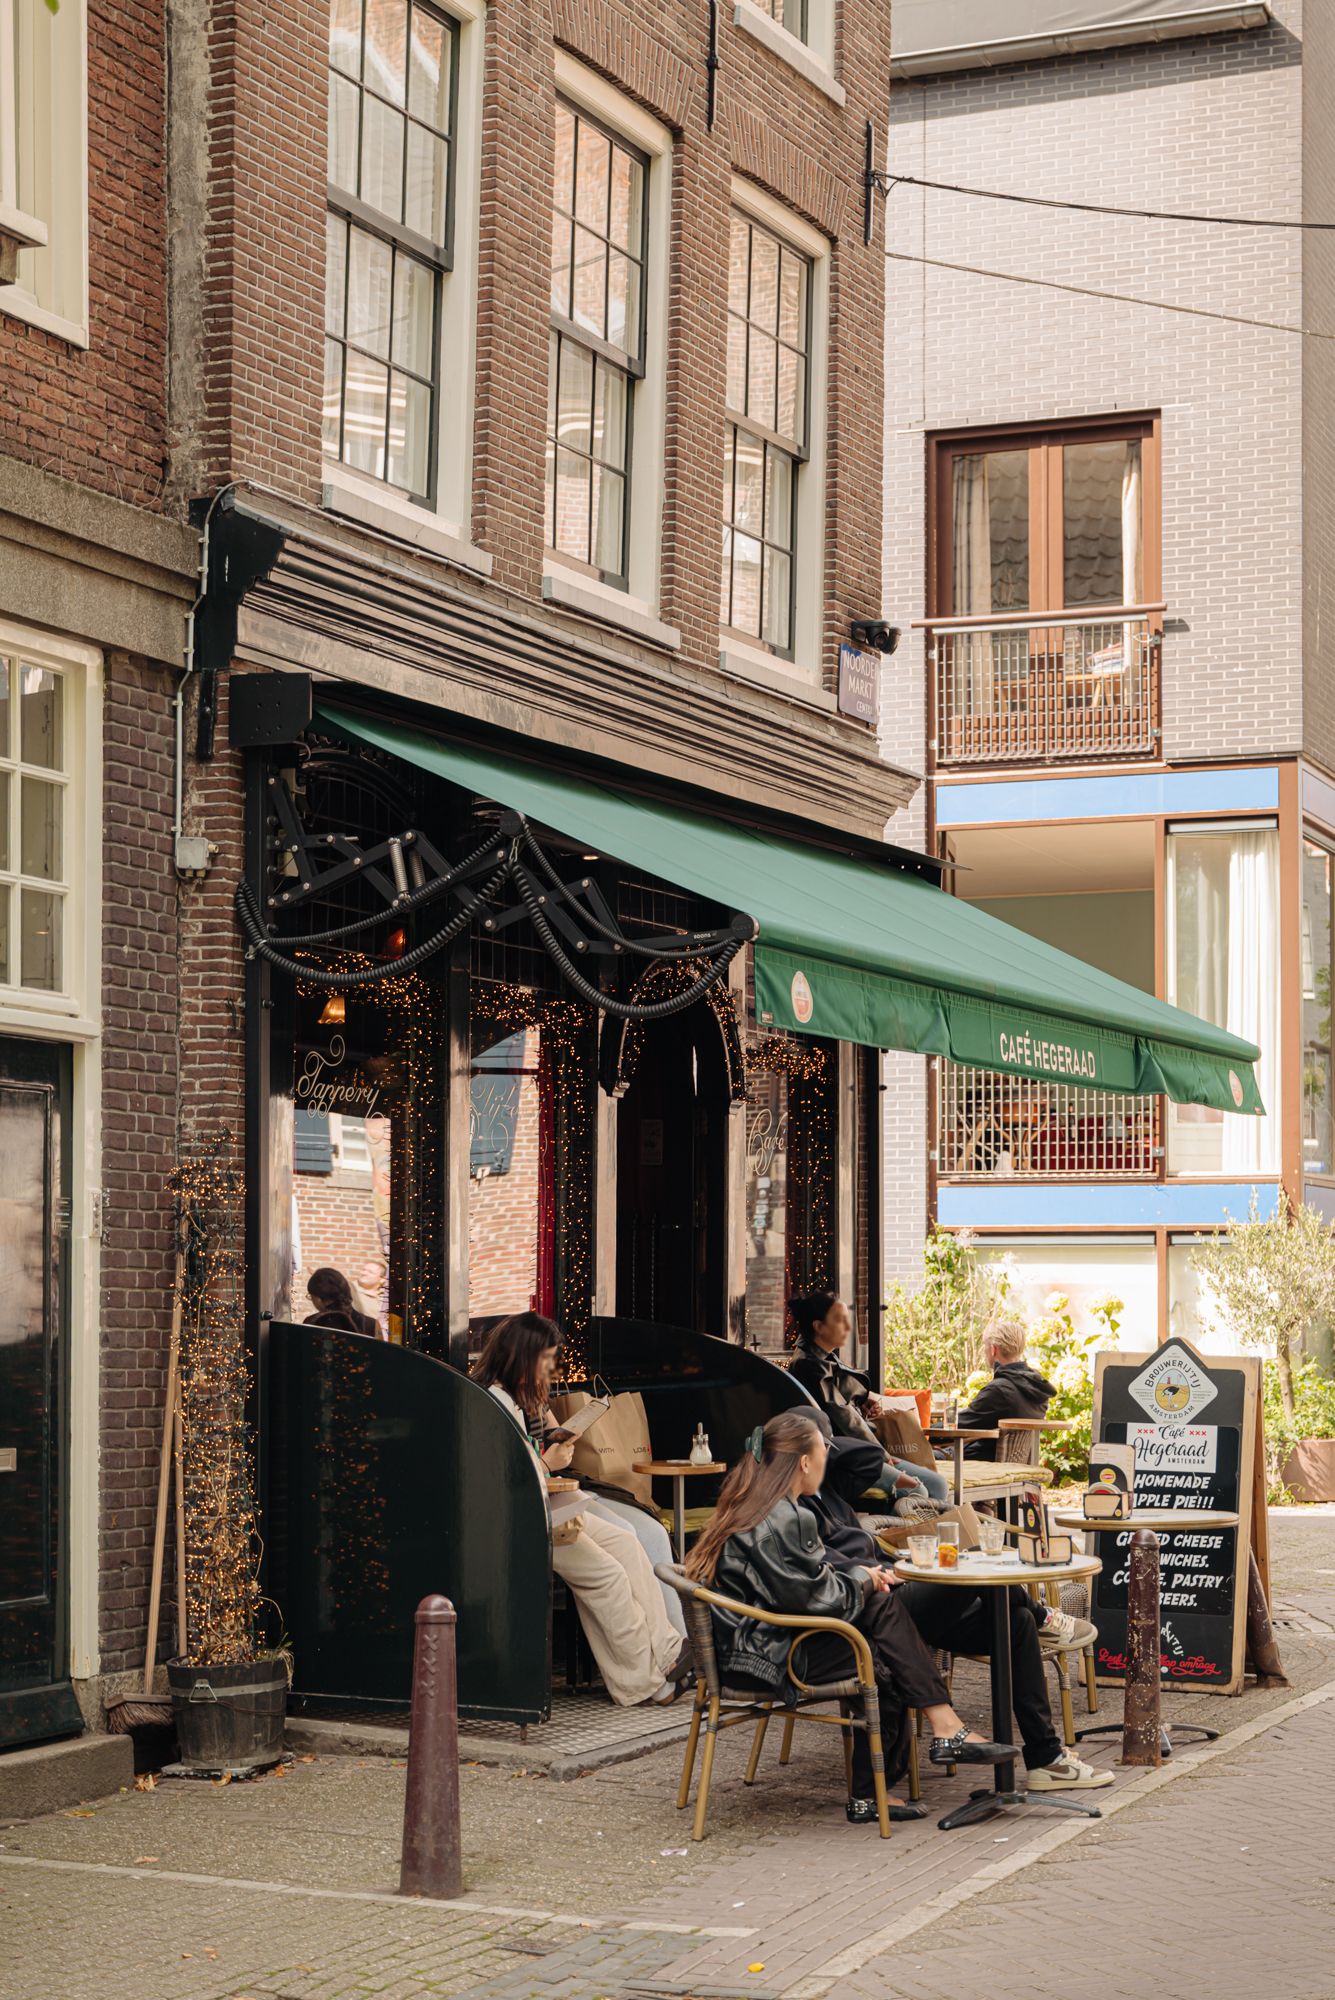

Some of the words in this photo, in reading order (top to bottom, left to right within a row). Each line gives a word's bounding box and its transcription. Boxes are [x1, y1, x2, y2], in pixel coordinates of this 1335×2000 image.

[848, 675, 874, 700] MARKT
[1000, 1029, 1032, 1067] CAFÉ
[1033, 1039, 1096, 1079] HEGERAAD
[1149, 1403, 1195, 1420] AMSTERDAM
[1158, 1424, 1186, 1440] Café
[1133, 1436, 1209, 1467] Hegeraad
[1167, 1457, 1206, 1465] AMSTERDAM
[1133, 1473, 1212, 1490] HOMEMADE
[1173, 1494, 1215, 1510] PIE!!!
[1173, 1533, 1224, 1549] CHEESE
[1124, 1552, 1210, 1568] SWICHES.
[1171, 1573, 1225, 1589] PASTRY
